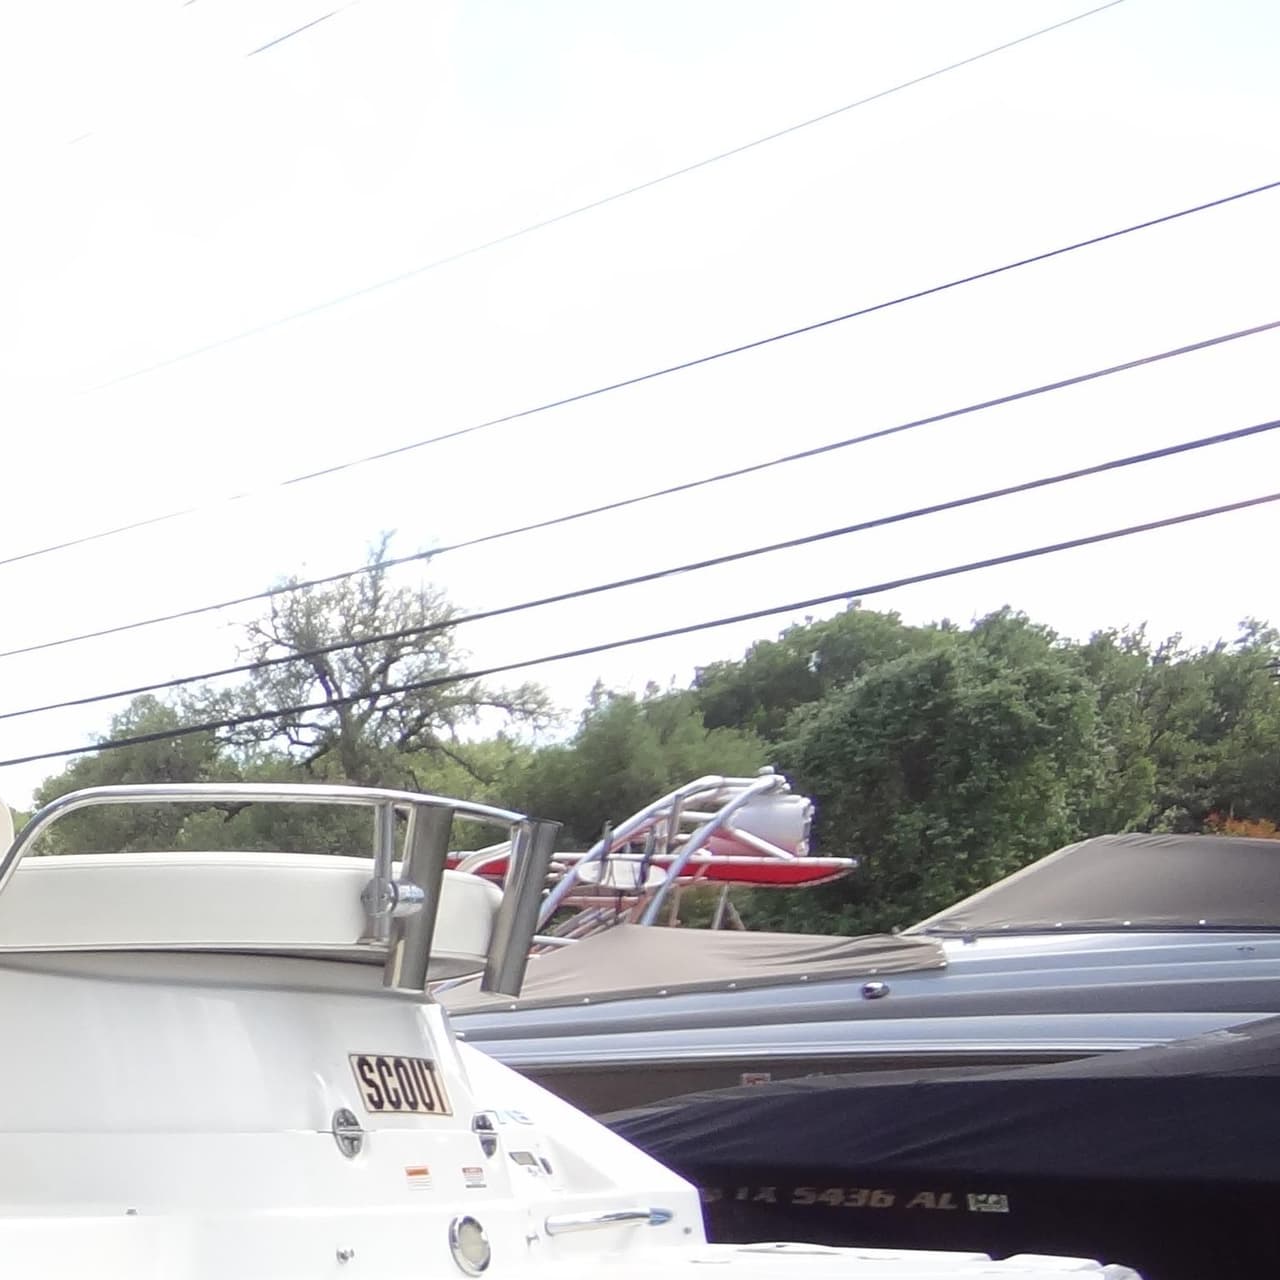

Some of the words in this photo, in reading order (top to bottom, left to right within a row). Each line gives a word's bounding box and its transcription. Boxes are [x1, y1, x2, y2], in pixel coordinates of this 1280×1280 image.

[357, 1056, 447, 1112] SCOUT
[791, 1186, 897, 1208] 5436
[905, 1191, 958, 1210] AL
